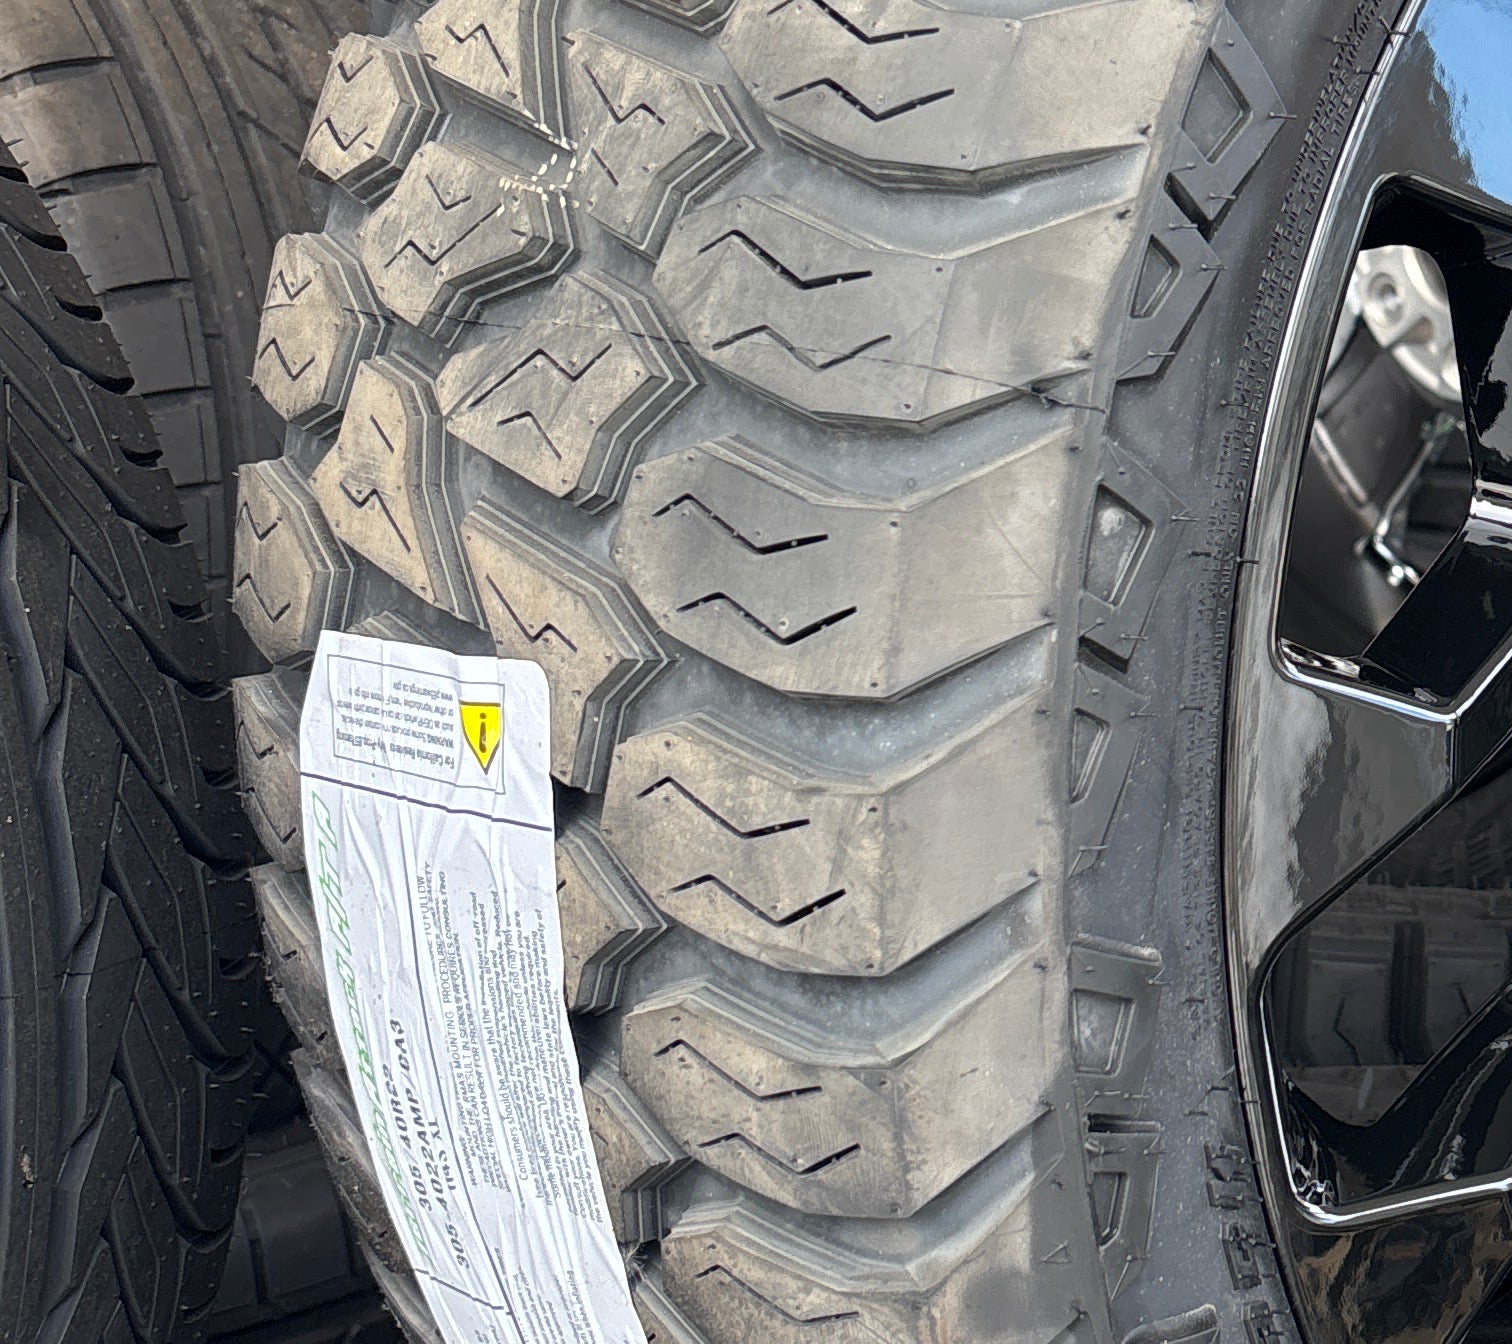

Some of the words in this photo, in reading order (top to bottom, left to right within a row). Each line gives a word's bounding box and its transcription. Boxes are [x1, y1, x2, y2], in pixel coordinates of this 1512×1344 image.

[1286, 220, 1313, 261] FOR
[1302, 145, 1334, 215] RADIAL
[444, 1009, 463, 1069] MOUNTING
[513, 991, 536, 1065] recommended
[460, 1052, 476, 1094] RESULT
[382, 1063, 432, 1210] 305/40R22
[496, 1091, 516, 1125] should
[508, 1125, 529, 1181] Consumers
